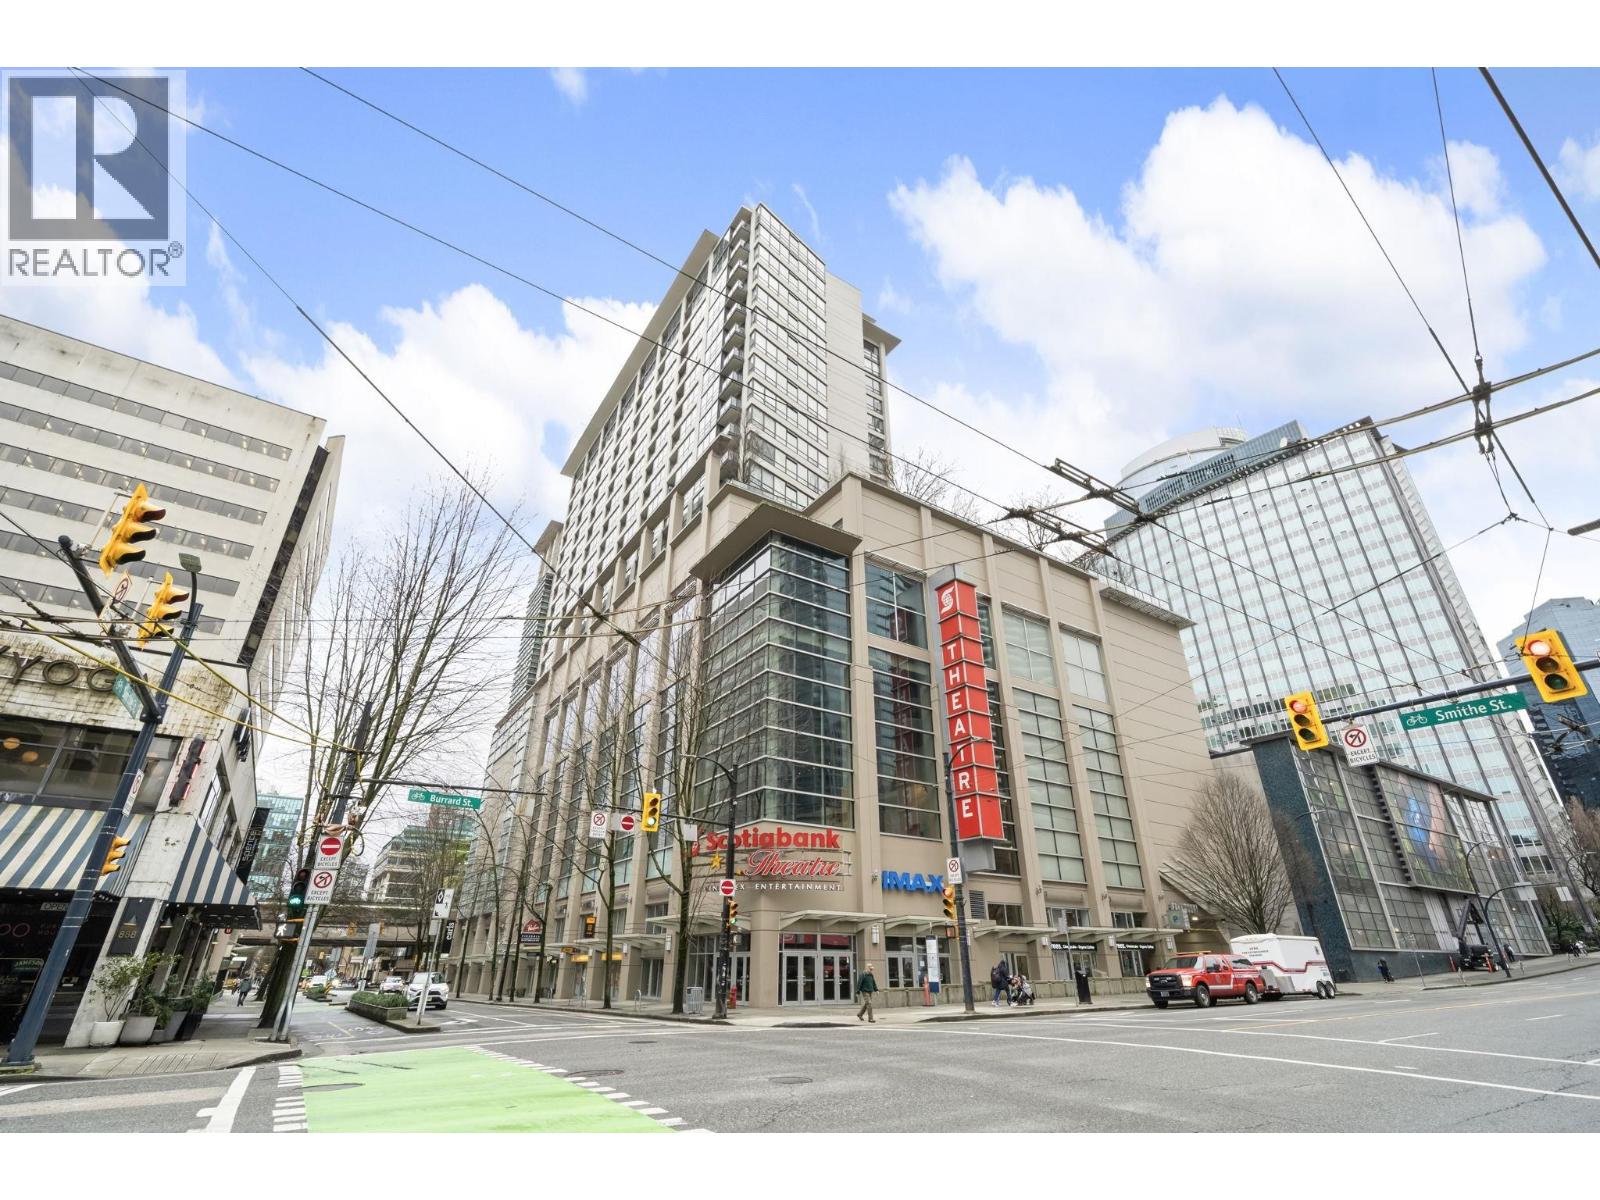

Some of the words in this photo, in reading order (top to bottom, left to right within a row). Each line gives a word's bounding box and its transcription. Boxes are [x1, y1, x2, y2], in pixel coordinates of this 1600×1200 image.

[1435, 701, 1488, 721] Smithe
[1491, 699, 1513, 711] St.
[947, 643, 974, 819] THEATRE
[430, 794, 461, 806] Burrard
[462, 798, 473, 807] St.
[706, 827, 841, 850] Scotiabank
[744, 849, 840, 877] Theatre
[755, 883, 841, 892] ENTERTAINMENT
[881, 870, 944, 894] IMAX
